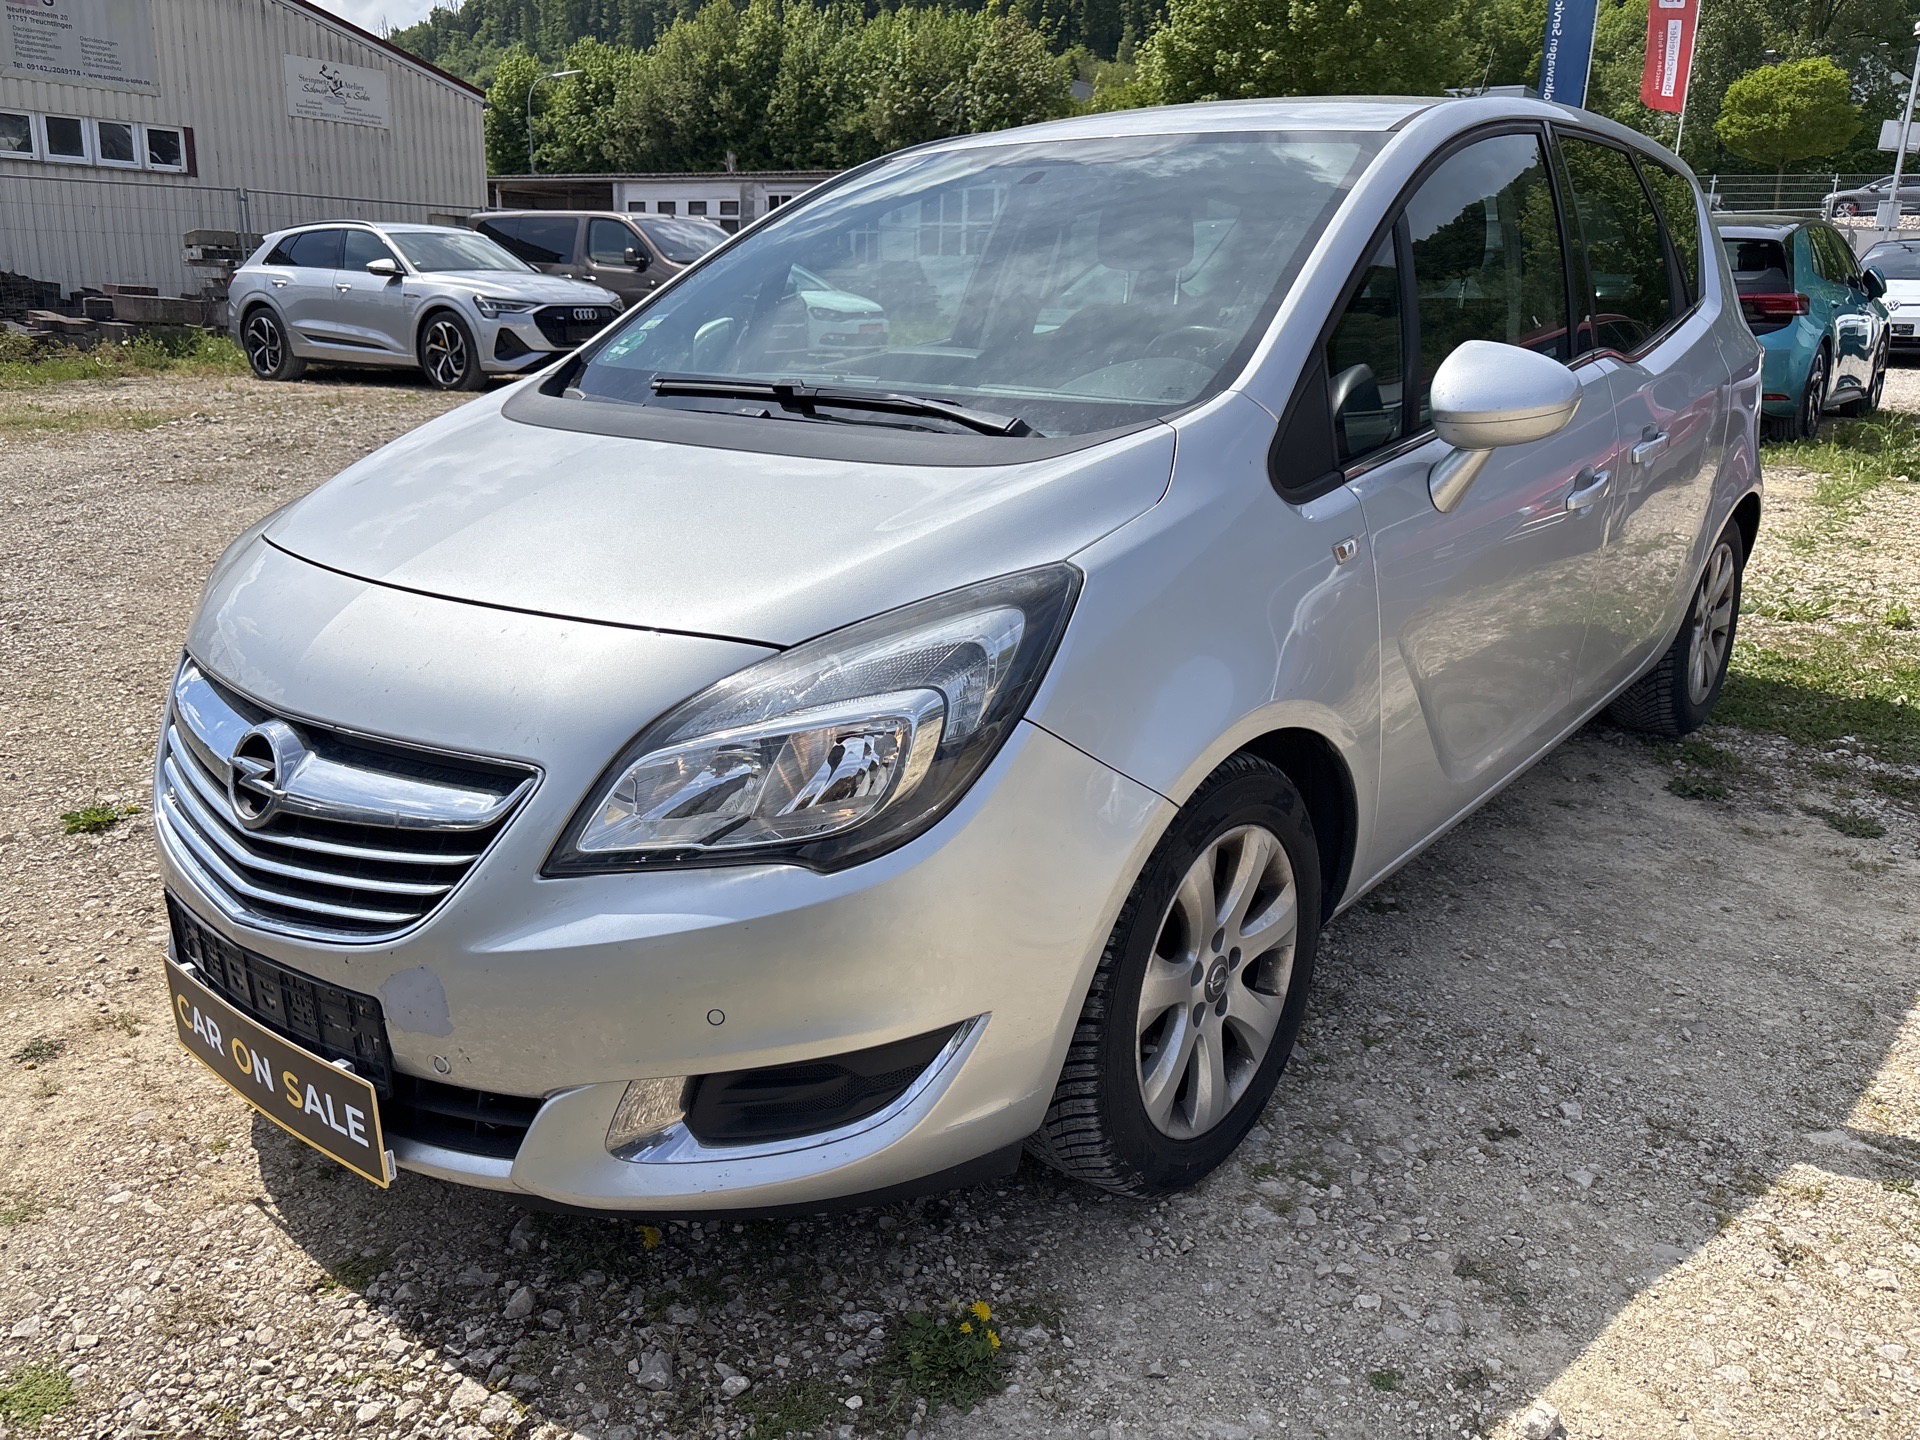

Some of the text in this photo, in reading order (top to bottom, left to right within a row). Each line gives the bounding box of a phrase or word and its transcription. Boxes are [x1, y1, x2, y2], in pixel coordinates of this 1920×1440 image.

[6, 5, 59, 20] Neufriedenheim
[7, 14, 73, 30] 91757 Treuchtlingen
[298, 73, 330, 86] Steinmetz
[177, 993, 370, 1149] CAR ON SALE
